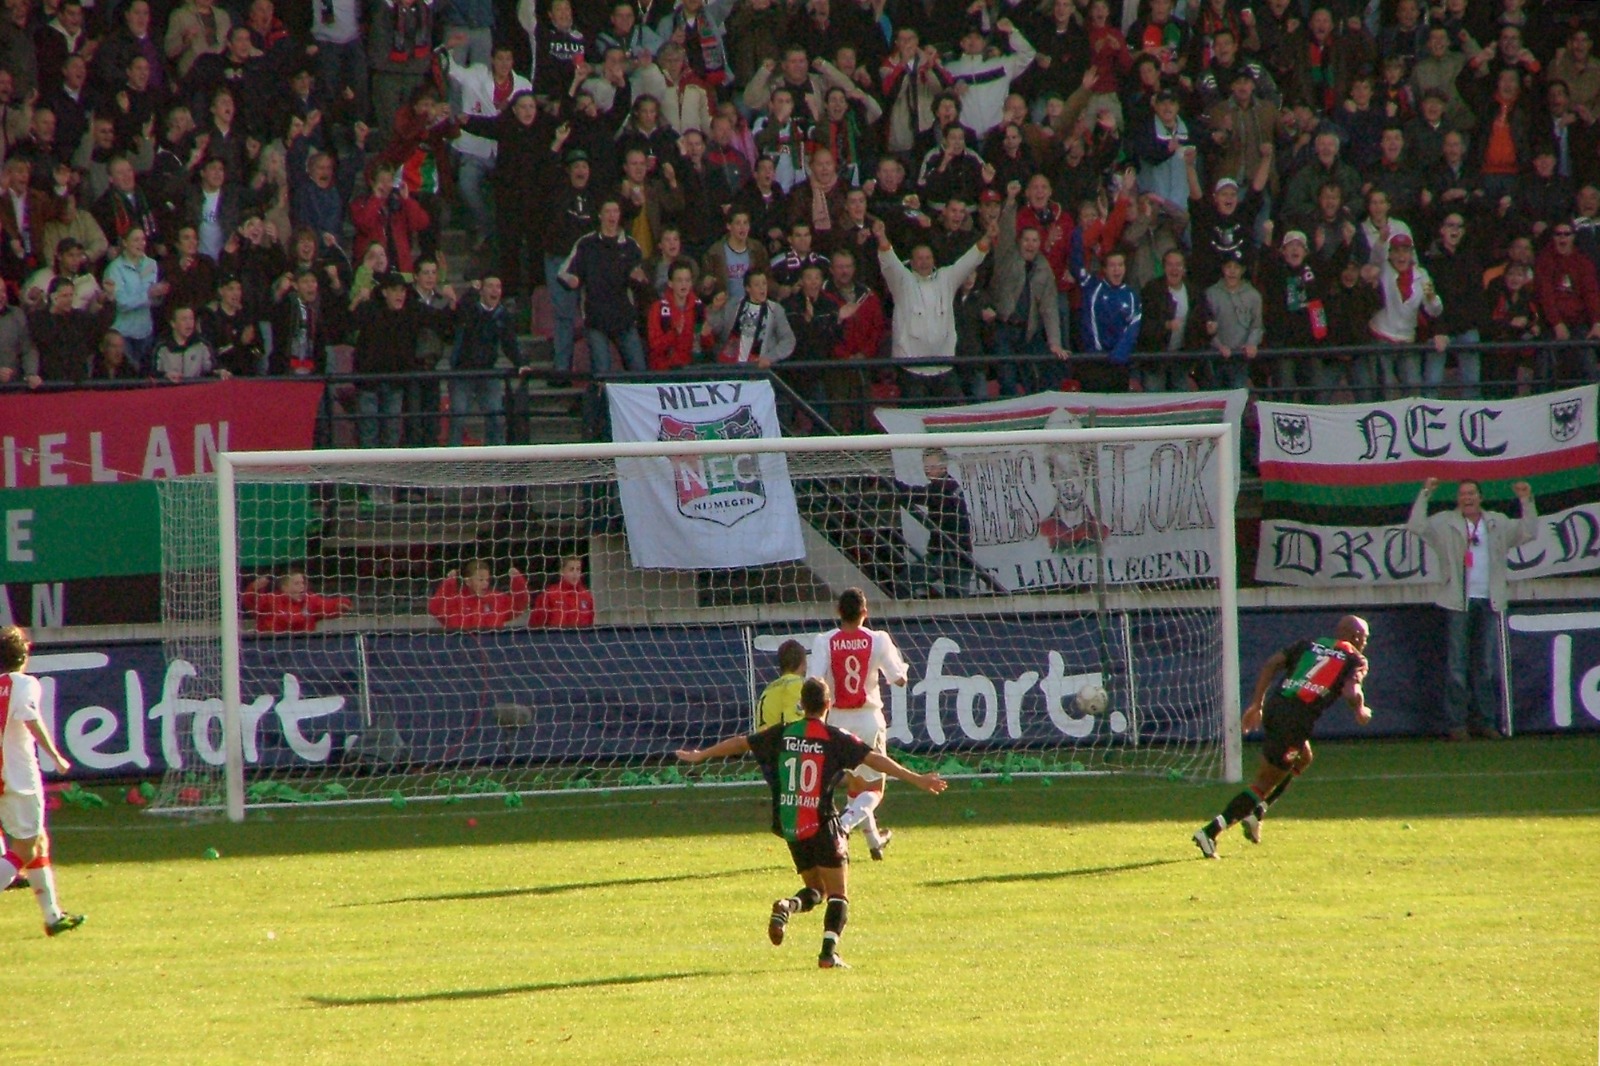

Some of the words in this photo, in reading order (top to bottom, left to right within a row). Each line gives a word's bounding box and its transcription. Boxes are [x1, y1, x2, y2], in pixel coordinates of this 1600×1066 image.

[656, 383, 742, 410] NICKY
[1355, 404, 1509, 461] NEC
[677, 452, 757, 491] NEC
[694, 497, 754, 511] NIJMEGEN
[1107, 549, 1212, 584] LEGEND
[833, 638, 869, 651] MADURO
[844, 655, 861, 694] 8
[782, 736, 824, 754] Telfort.
[784, 757, 819, 793] 10
